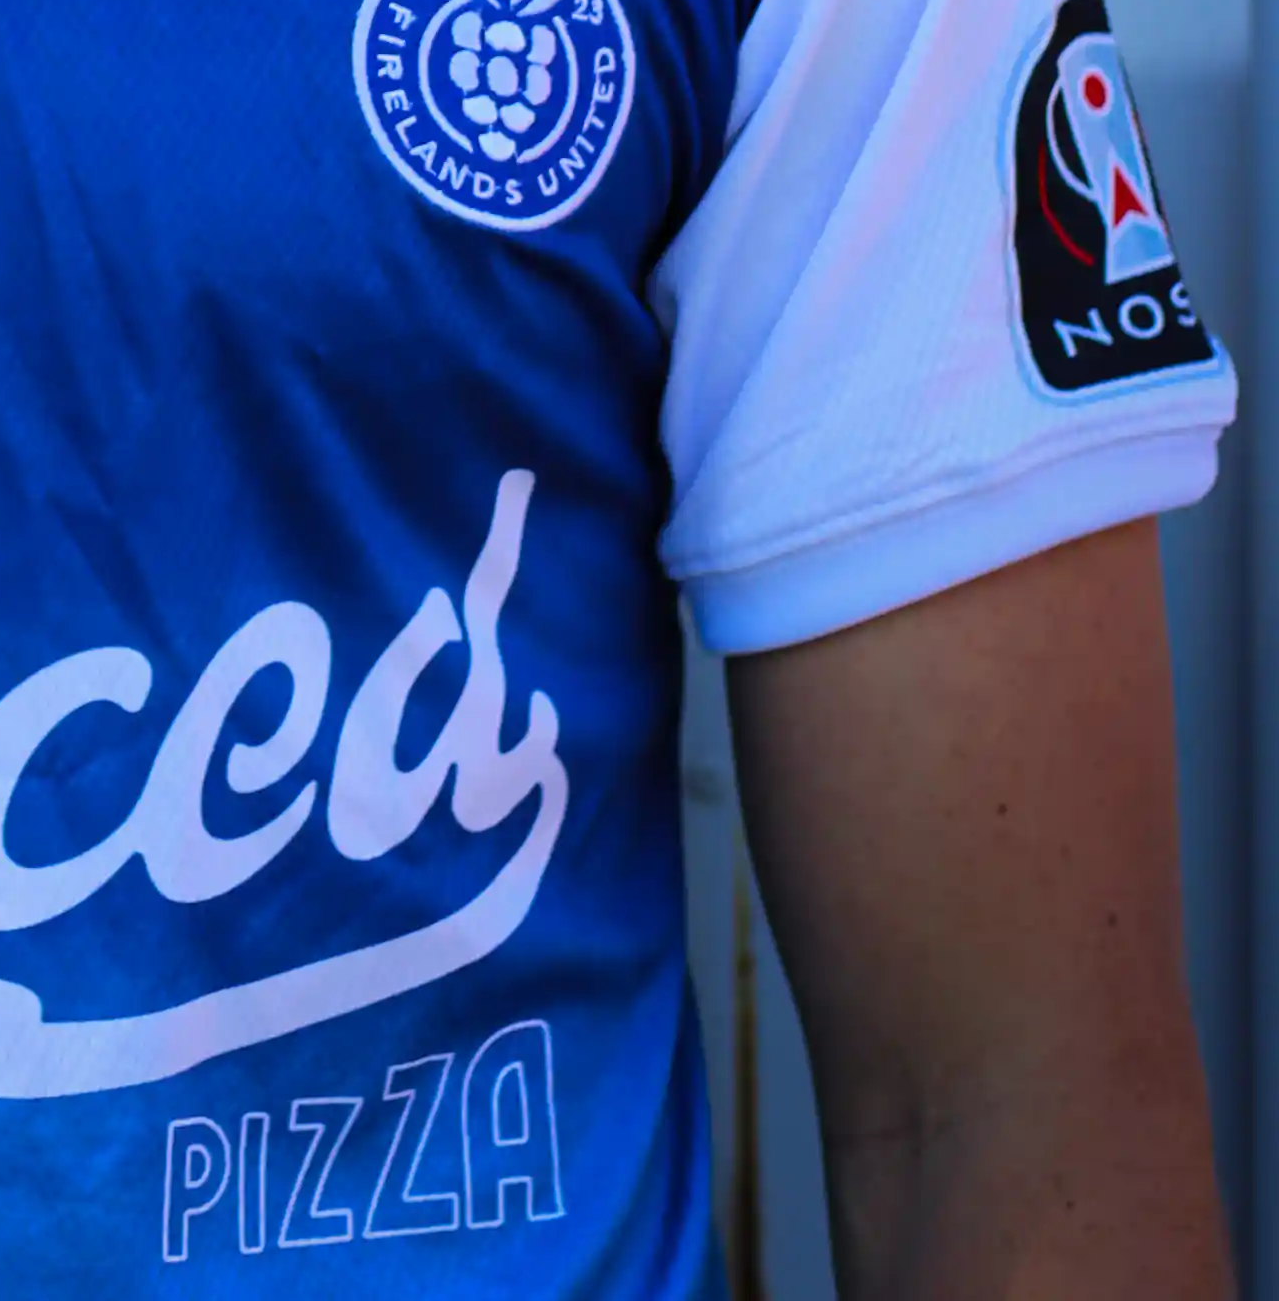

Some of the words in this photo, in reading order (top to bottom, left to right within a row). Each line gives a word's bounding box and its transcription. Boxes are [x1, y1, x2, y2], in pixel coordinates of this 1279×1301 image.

[376, 1, 524, 206] FIRELANDS
[537, 46, 616, 197] UNITED
[161, 1018, 567, 1263] PIZZA
